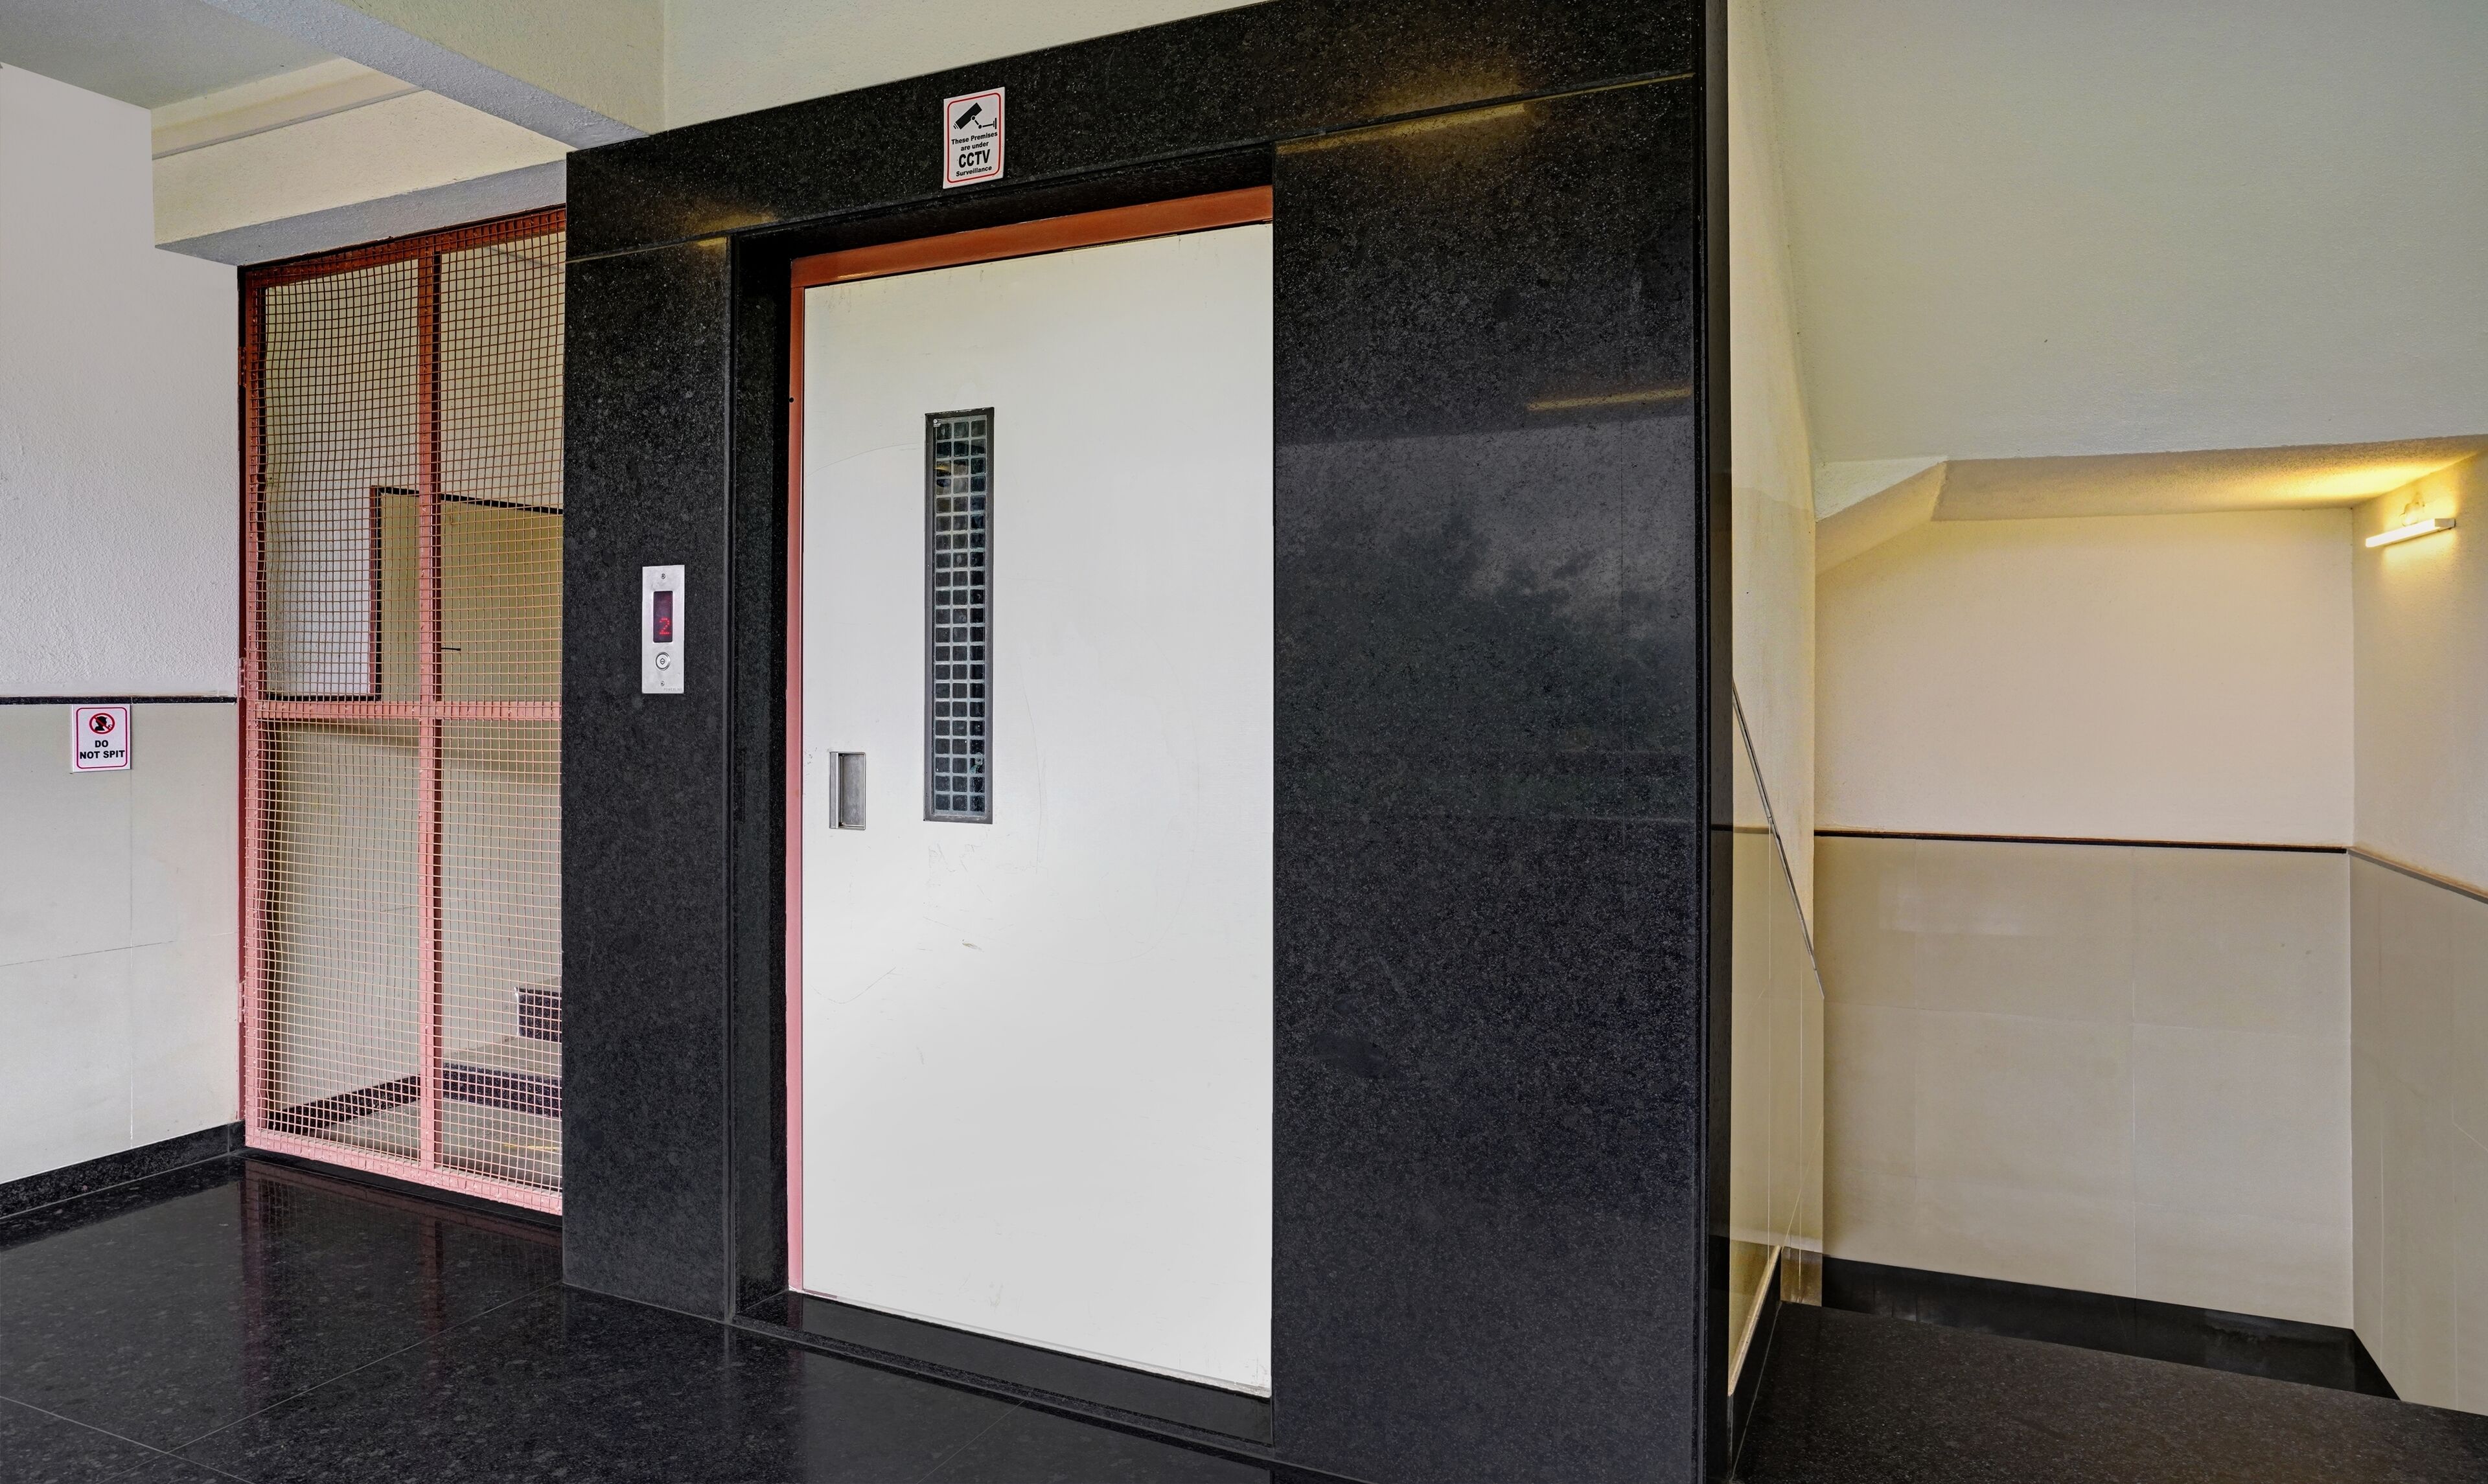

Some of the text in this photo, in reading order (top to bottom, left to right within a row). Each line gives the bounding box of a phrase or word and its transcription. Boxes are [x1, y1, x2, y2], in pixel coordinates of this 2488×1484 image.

[971, 132, 998, 141] Premises
[972, 141, 989, 149] under
[958, 149, 990, 168] CCTV
[956, 165, 992, 177] Surveillance
[659, 617, 670, 635] 2
